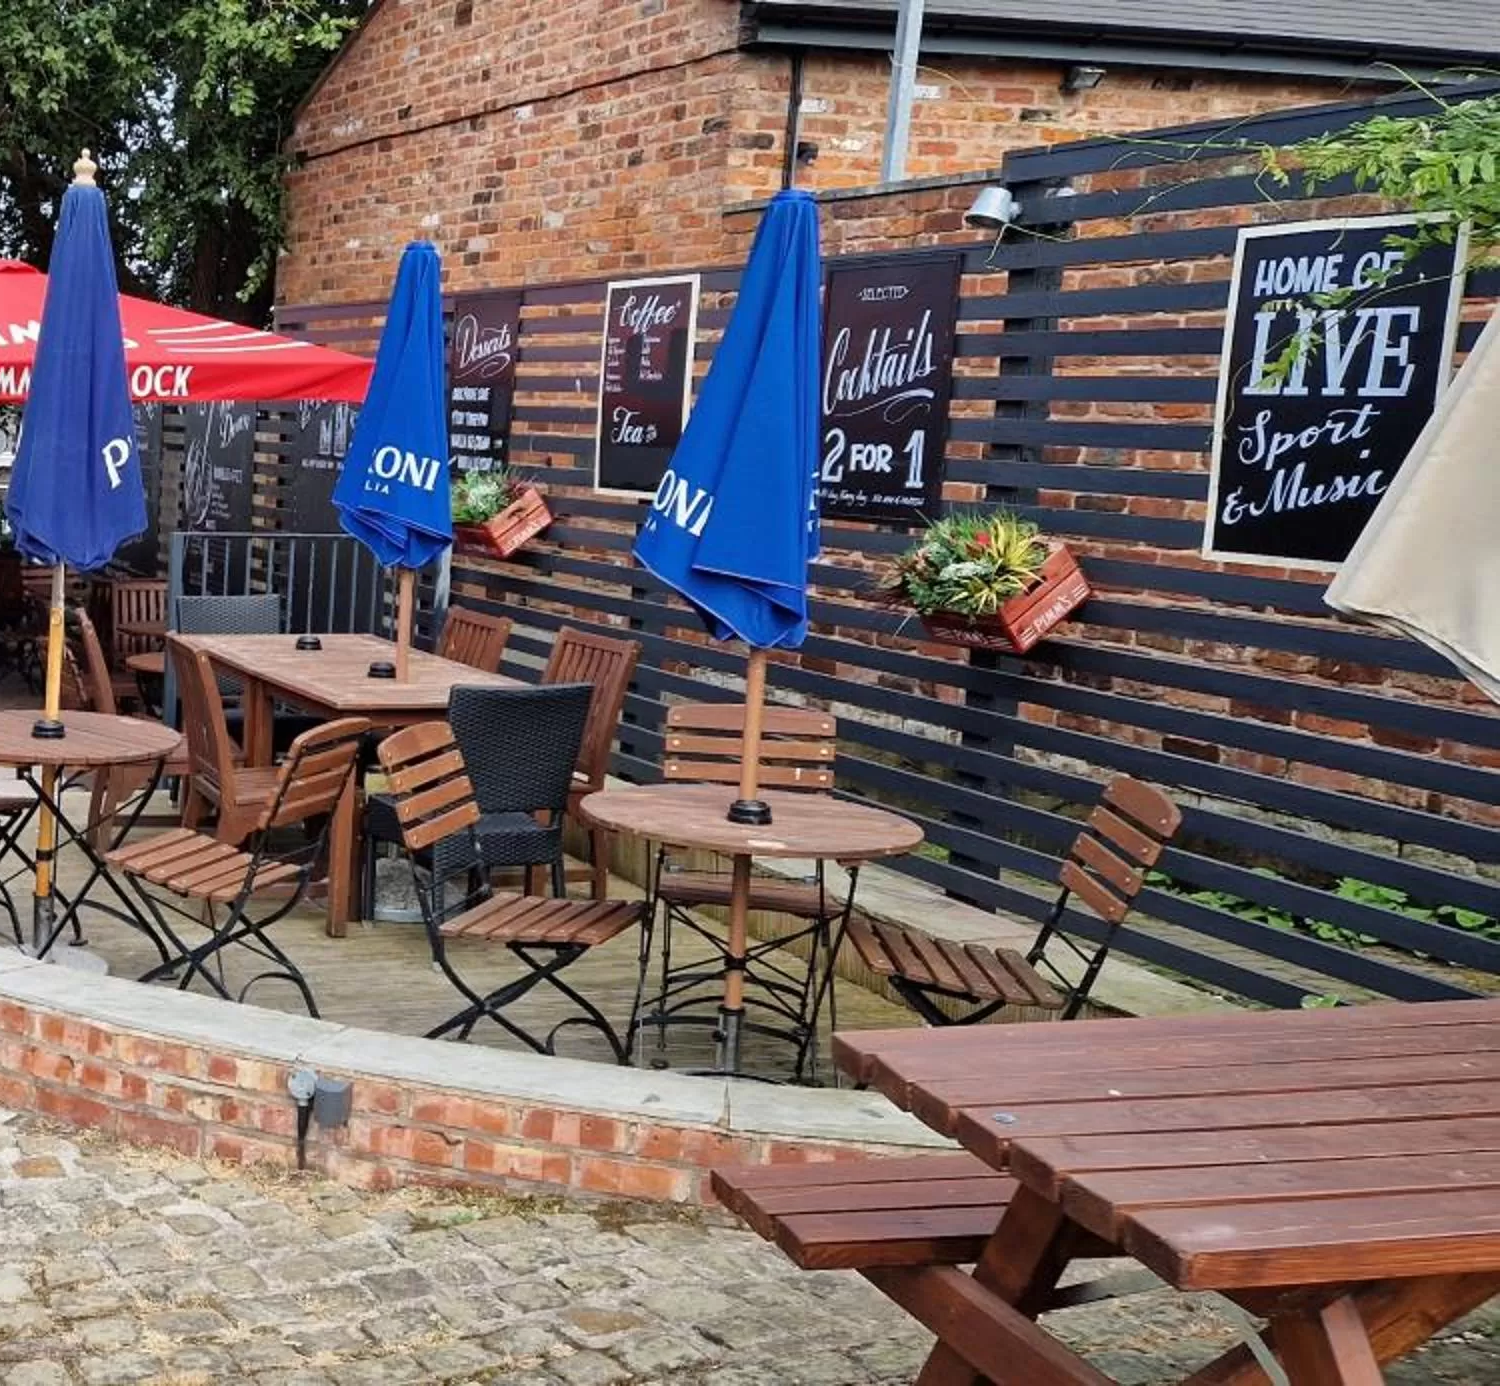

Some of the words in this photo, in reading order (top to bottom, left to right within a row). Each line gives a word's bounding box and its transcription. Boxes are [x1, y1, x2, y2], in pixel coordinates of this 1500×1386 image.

[1253, 254, 1344, 296] HOME
[823, 309, 937, 416] Cocktails
[1242, 306, 1421, 397] LIVE
[611, 406, 642, 444] Tea
[1238, 403, 1381, 471] Sport
[364, 479, 390, 495] LIA
[367, 446, 441, 491] ONI
[822, 427, 845, 483] 2
[849, 443, 893, 473] FOR
[902, 429, 925, 489] 1
[1221, 486, 1248, 525] &
[1249, 449, 1388, 517] Music
